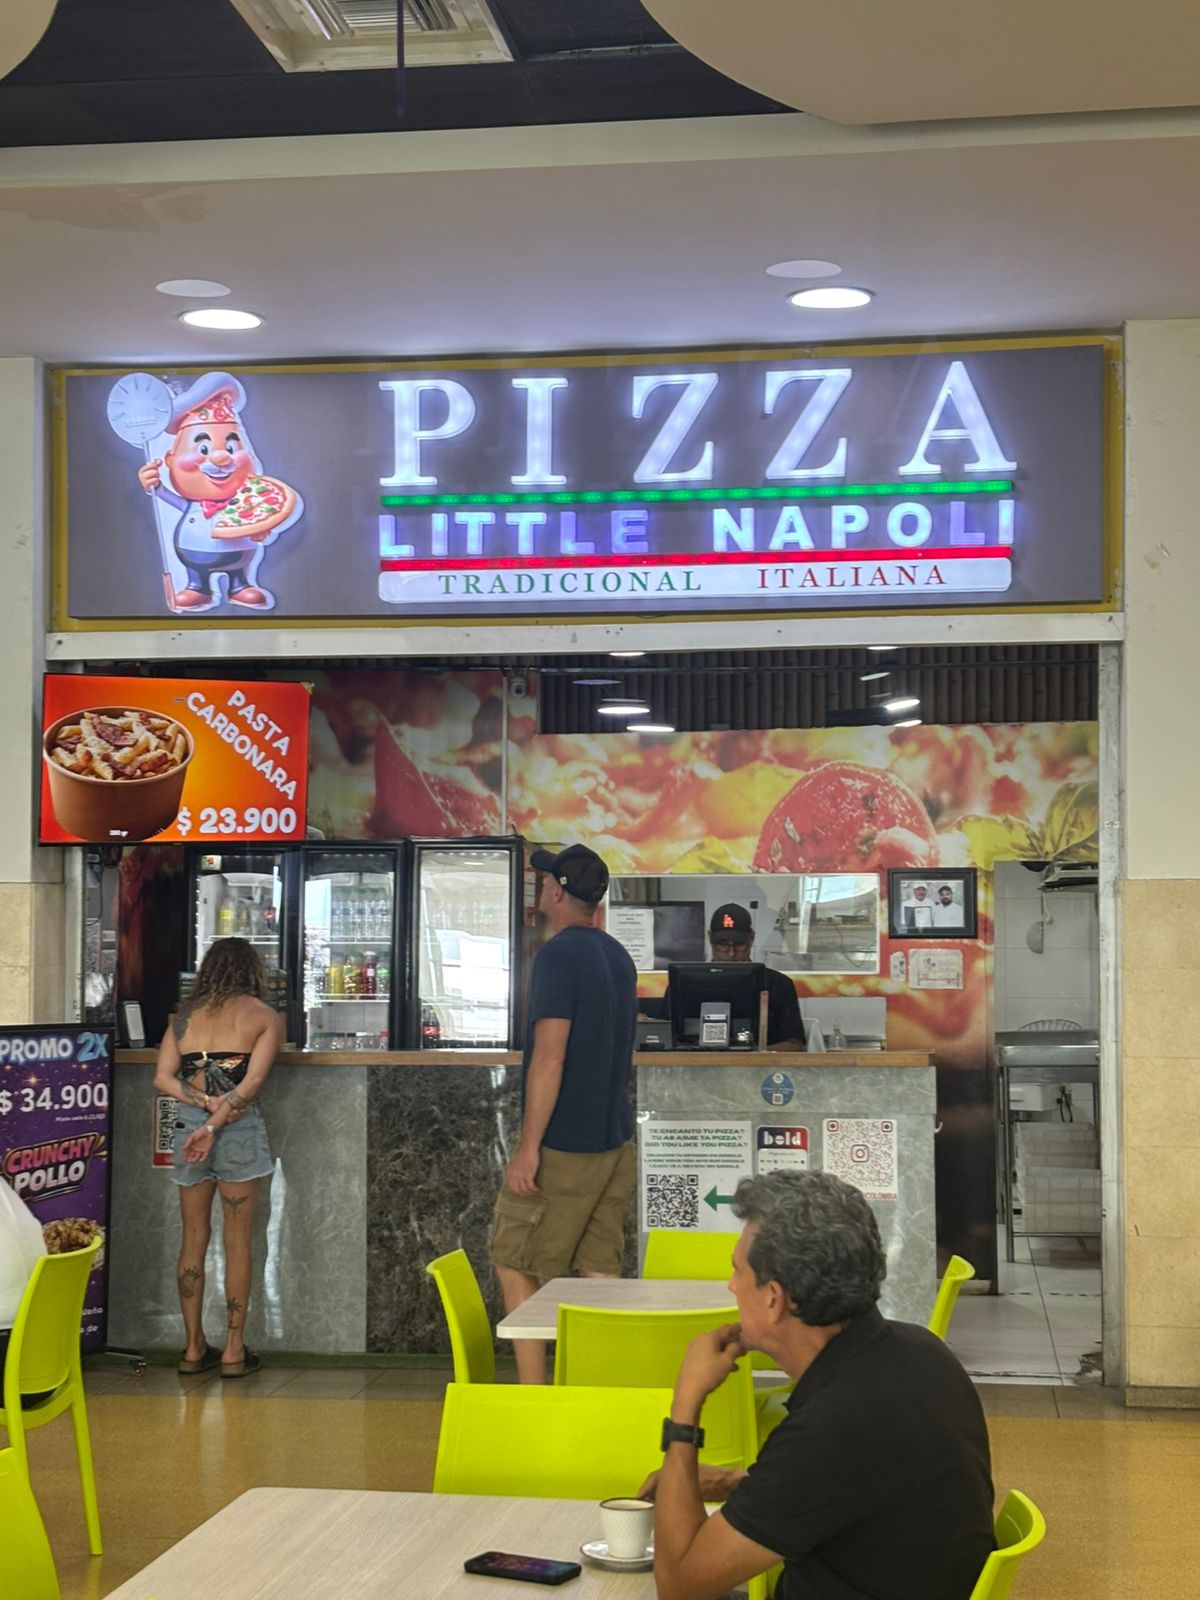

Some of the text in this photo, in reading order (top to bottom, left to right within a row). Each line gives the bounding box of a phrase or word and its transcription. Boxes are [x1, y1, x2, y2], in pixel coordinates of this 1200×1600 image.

[378, 360, 1018, 487] PIZZA
[378, 498, 1015, 558] LITTLE NAPOLI
[438, 562, 948, 597] TRADICIONAL ITALIANA
[227, 690, 290, 757] PASTA
[187, 691, 297, 801] CARBONARA
[176, 806, 297, 836] $ 23.900
[0, 1031, 109, 1062] PROMO 2X
[20, 1082, 108, 1112] 34.900
[7, 1134, 96, 1173] CRUNCHY
[763, 1131, 802, 1146] bold
[14, 1159, 87, 1195] POLLO
